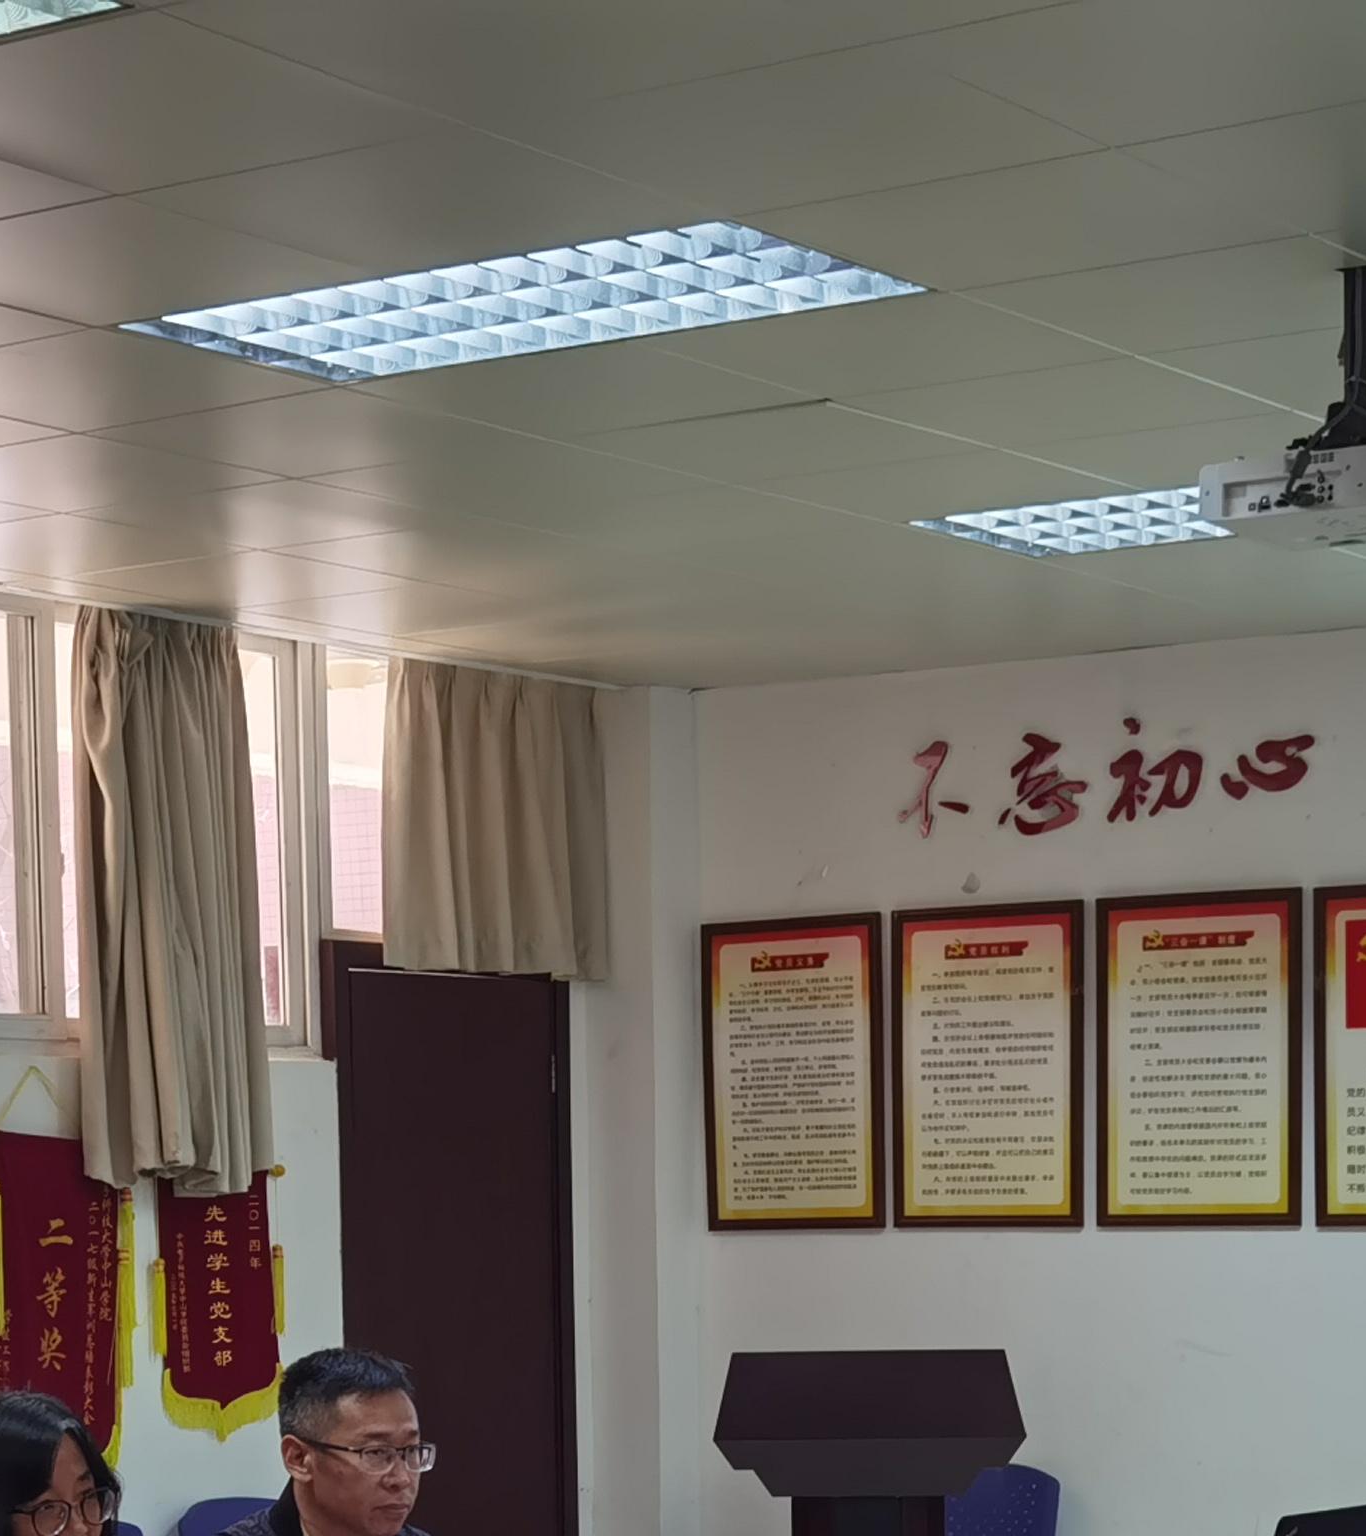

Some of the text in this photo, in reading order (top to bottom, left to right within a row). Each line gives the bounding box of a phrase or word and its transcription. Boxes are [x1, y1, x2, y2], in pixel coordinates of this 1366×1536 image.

[898, 717, 1316, 839] 不忘初心
[36, 1217, 74, 1372] 二等奖
[203, 1204, 233, 1368] 先进学生党支部
